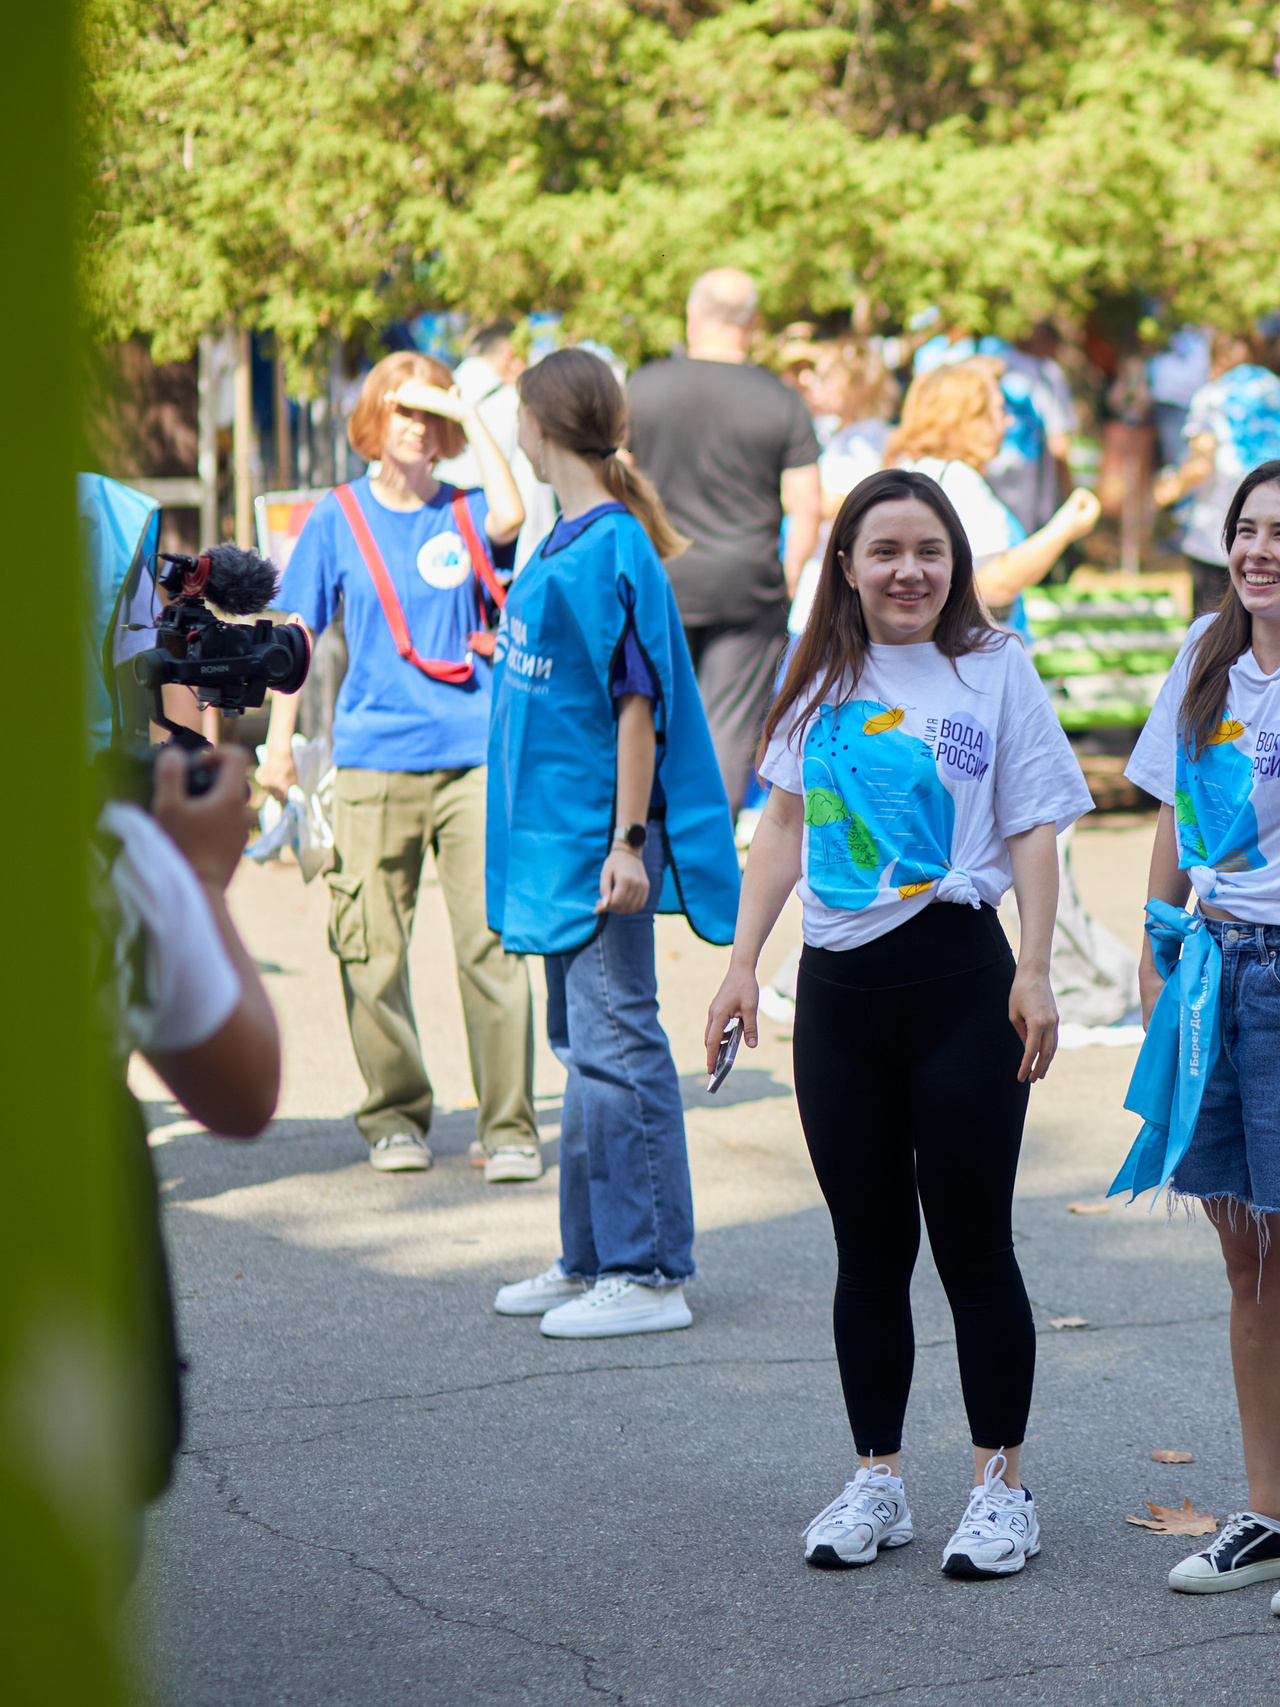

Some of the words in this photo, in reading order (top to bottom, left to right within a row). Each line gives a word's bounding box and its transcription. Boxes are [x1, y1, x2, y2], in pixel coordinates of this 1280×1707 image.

[200, 664, 230, 674] RONIN
[920, 718, 938, 759] АКЦИЯ
[940, 718, 983, 752] ВОДА
